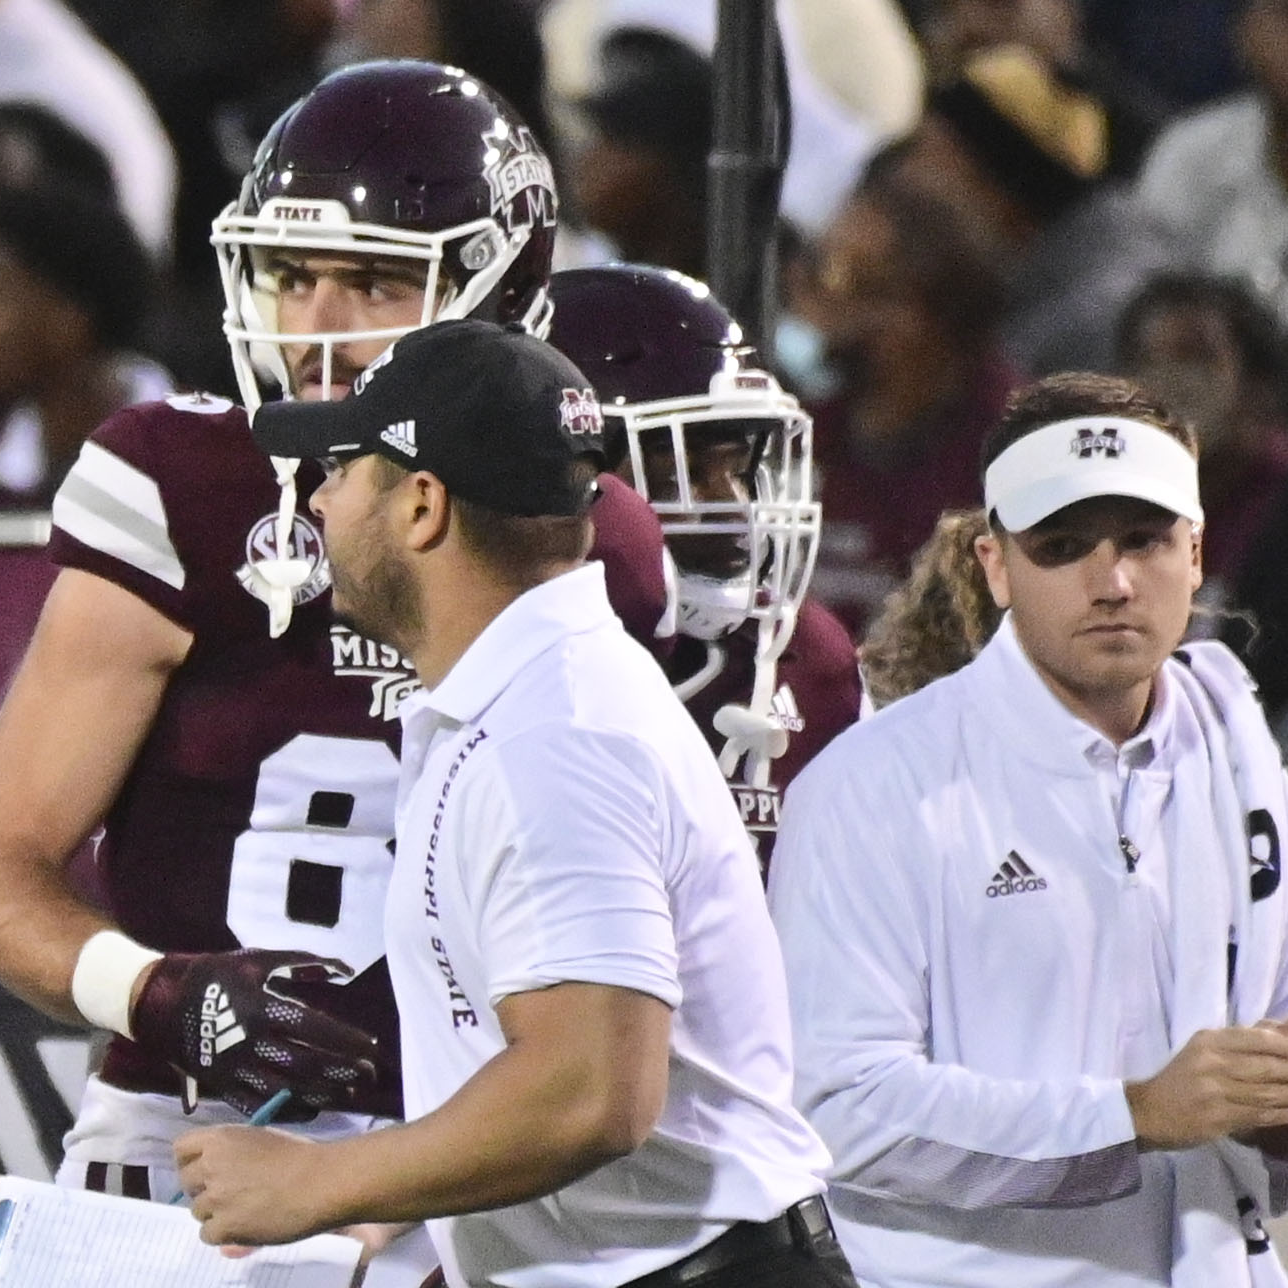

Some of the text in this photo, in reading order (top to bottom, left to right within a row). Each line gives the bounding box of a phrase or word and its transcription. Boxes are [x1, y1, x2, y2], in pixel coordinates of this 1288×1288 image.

[274, 206, 322, 222] STATE
[986, 877, 1048, 898] adidas
[199, 983, 221, 1067] adidas
